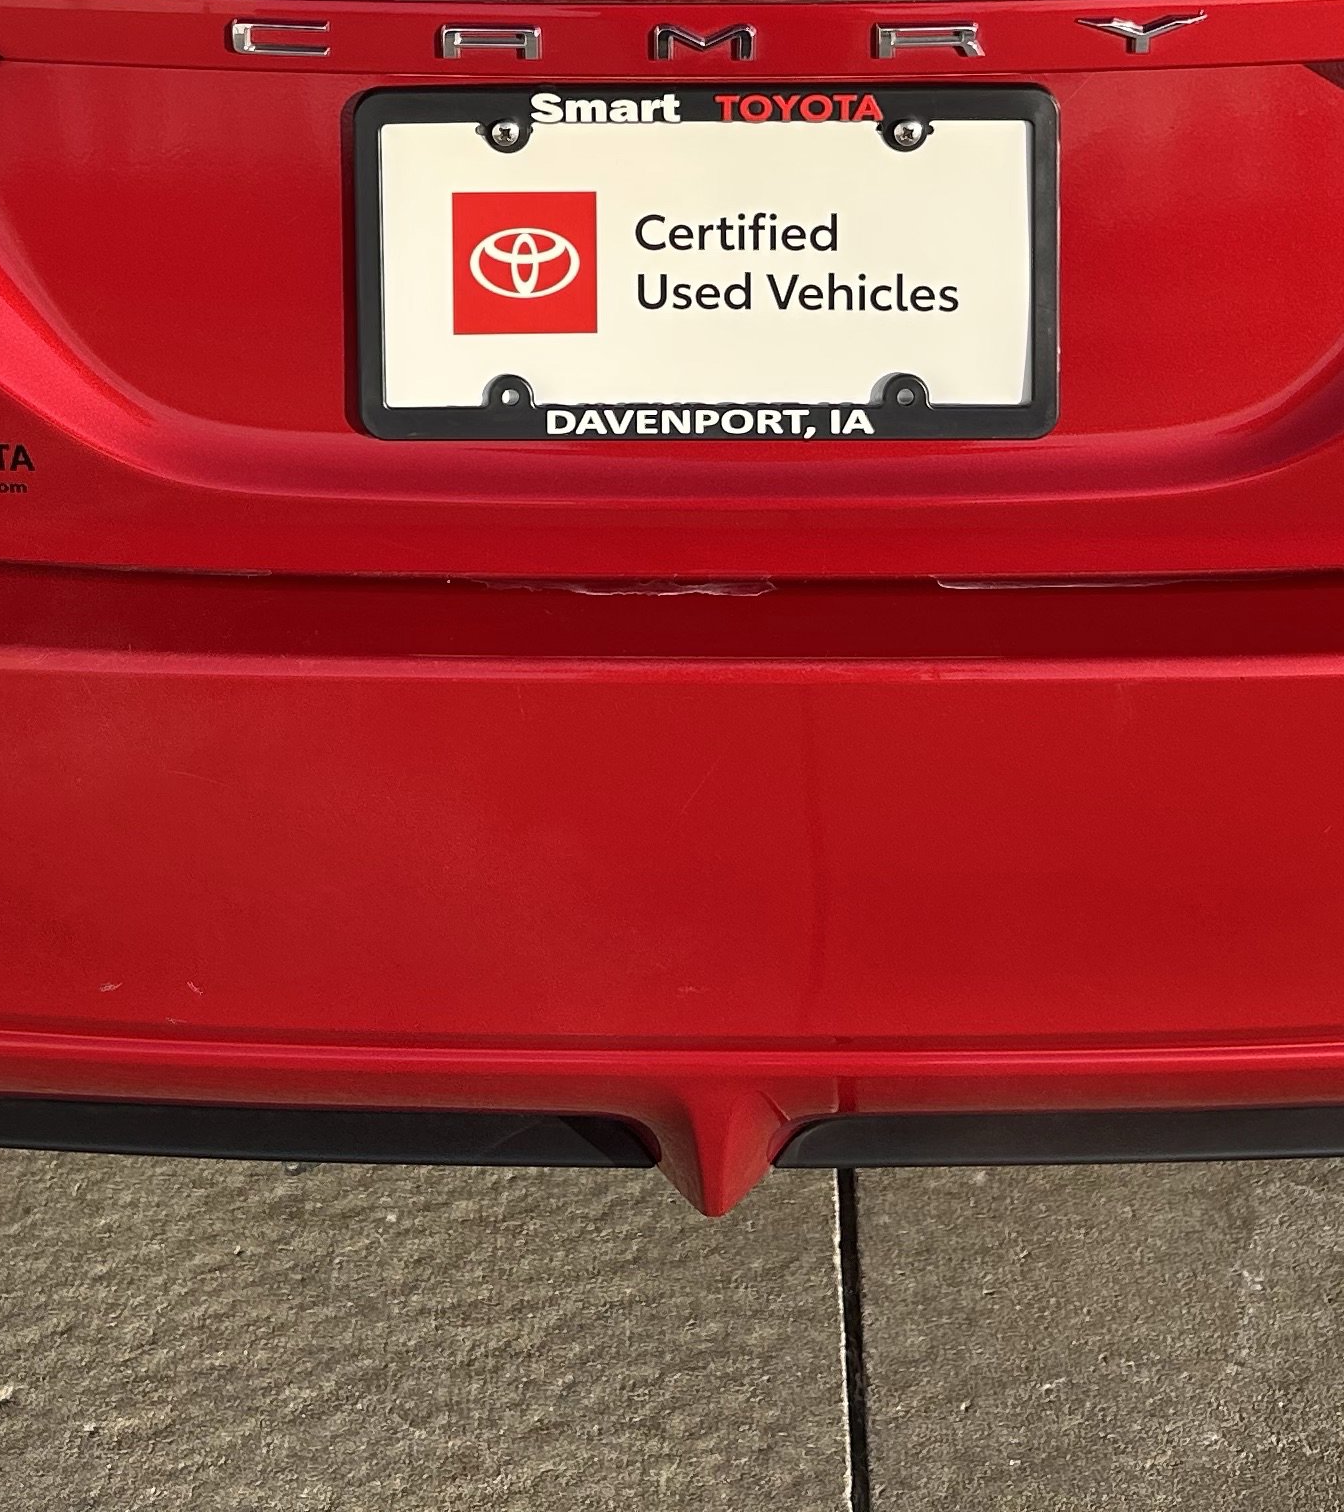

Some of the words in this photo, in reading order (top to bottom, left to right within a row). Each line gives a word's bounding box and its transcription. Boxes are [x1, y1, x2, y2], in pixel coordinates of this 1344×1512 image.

[225, 9, 1208, 62] CAMRY
[530, 92, 681, 123] Smart
[714, 93, 884, 123] TOYOTA
[634, 212, 838, 251] Certified
[636, 271, 752, 310] Used
[765, 272, 960, 312] Vehicles
[546, 408, 817, 439] DAVENPORT,
[830, 408, 875, 435] IA
